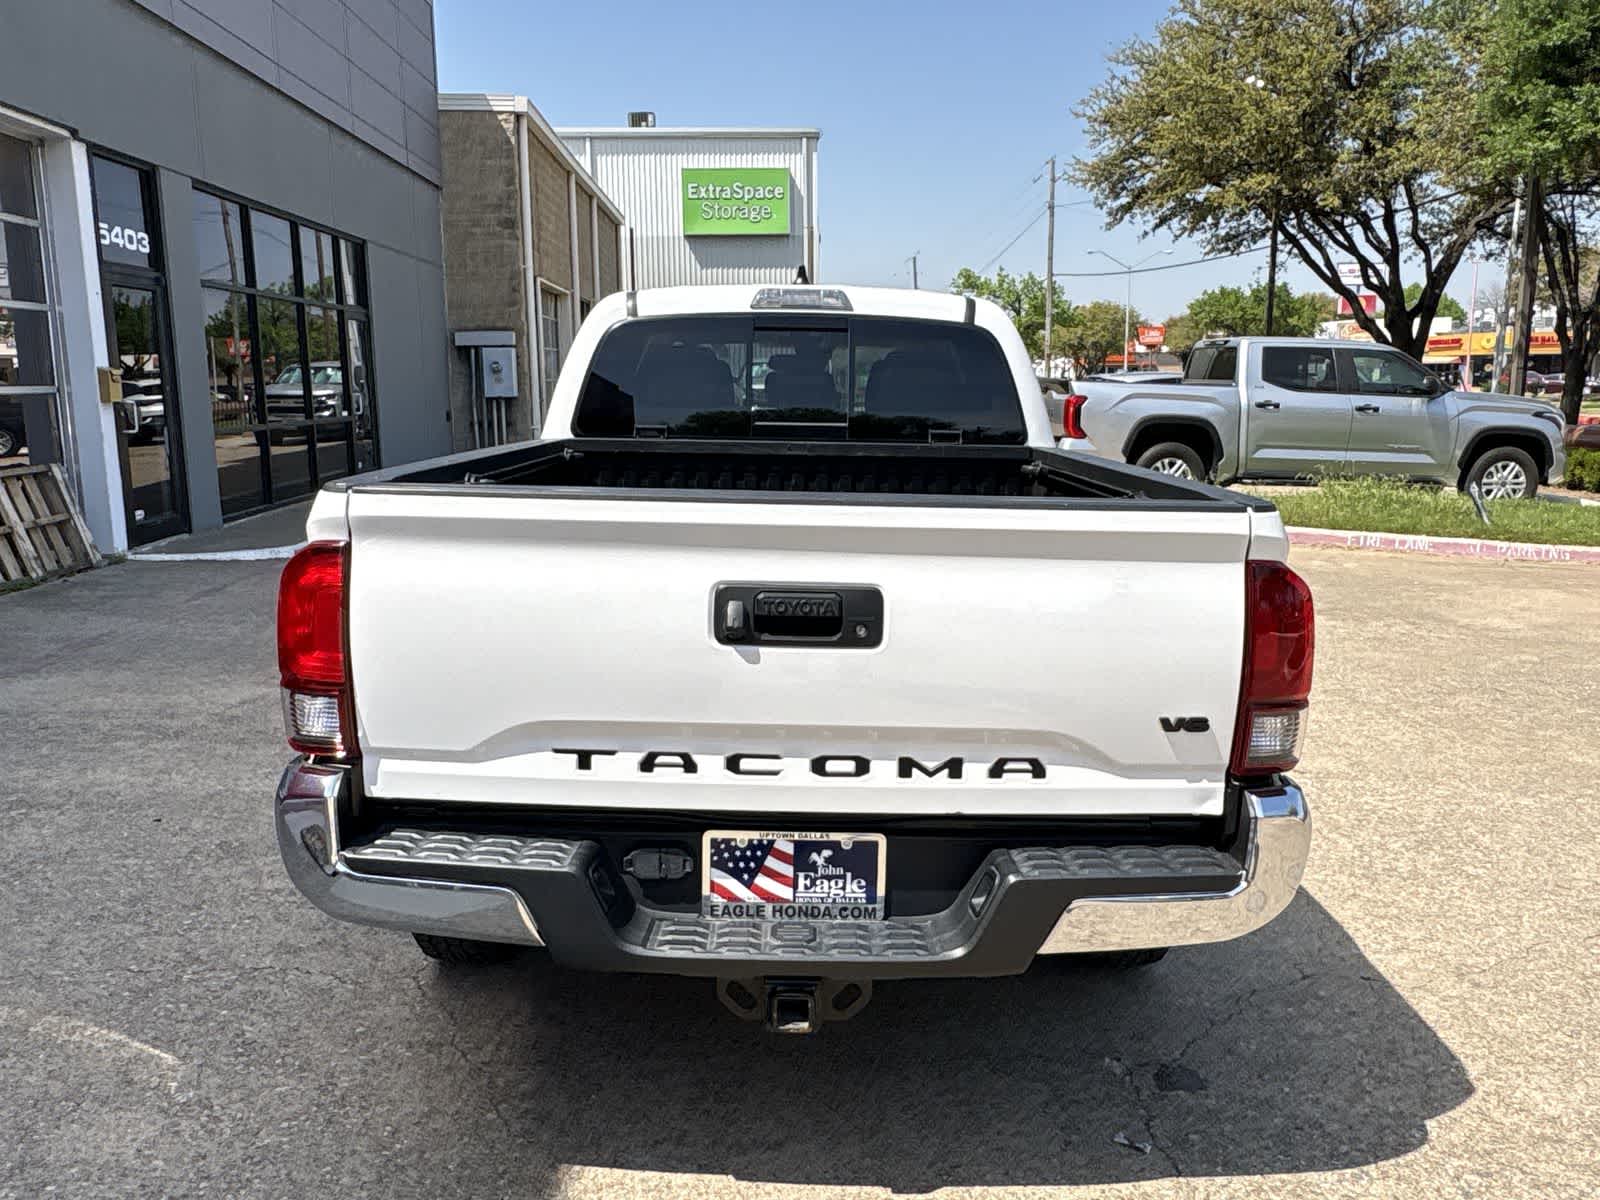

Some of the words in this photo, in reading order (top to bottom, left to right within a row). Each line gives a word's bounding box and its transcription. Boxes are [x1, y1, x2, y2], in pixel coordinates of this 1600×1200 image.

[687, 182, 784, 203] ExtraSpace
[702, 201, 772, 223] Storage
[98, 222, 150, 254] 5403
[763, 600, 840, 616] TOYOTA
[1158, 717, 1210, 732] V6
[552, 748, 1047, 779] TACOMA
[815, 864, 844, 877] John
[796, 872, 866, 898] Eagle
[835, 896, 866, 904] DALLAS
[710, 904, 766, 918] EAGLE
[772, 905, 878, 919] HONDA.COM
